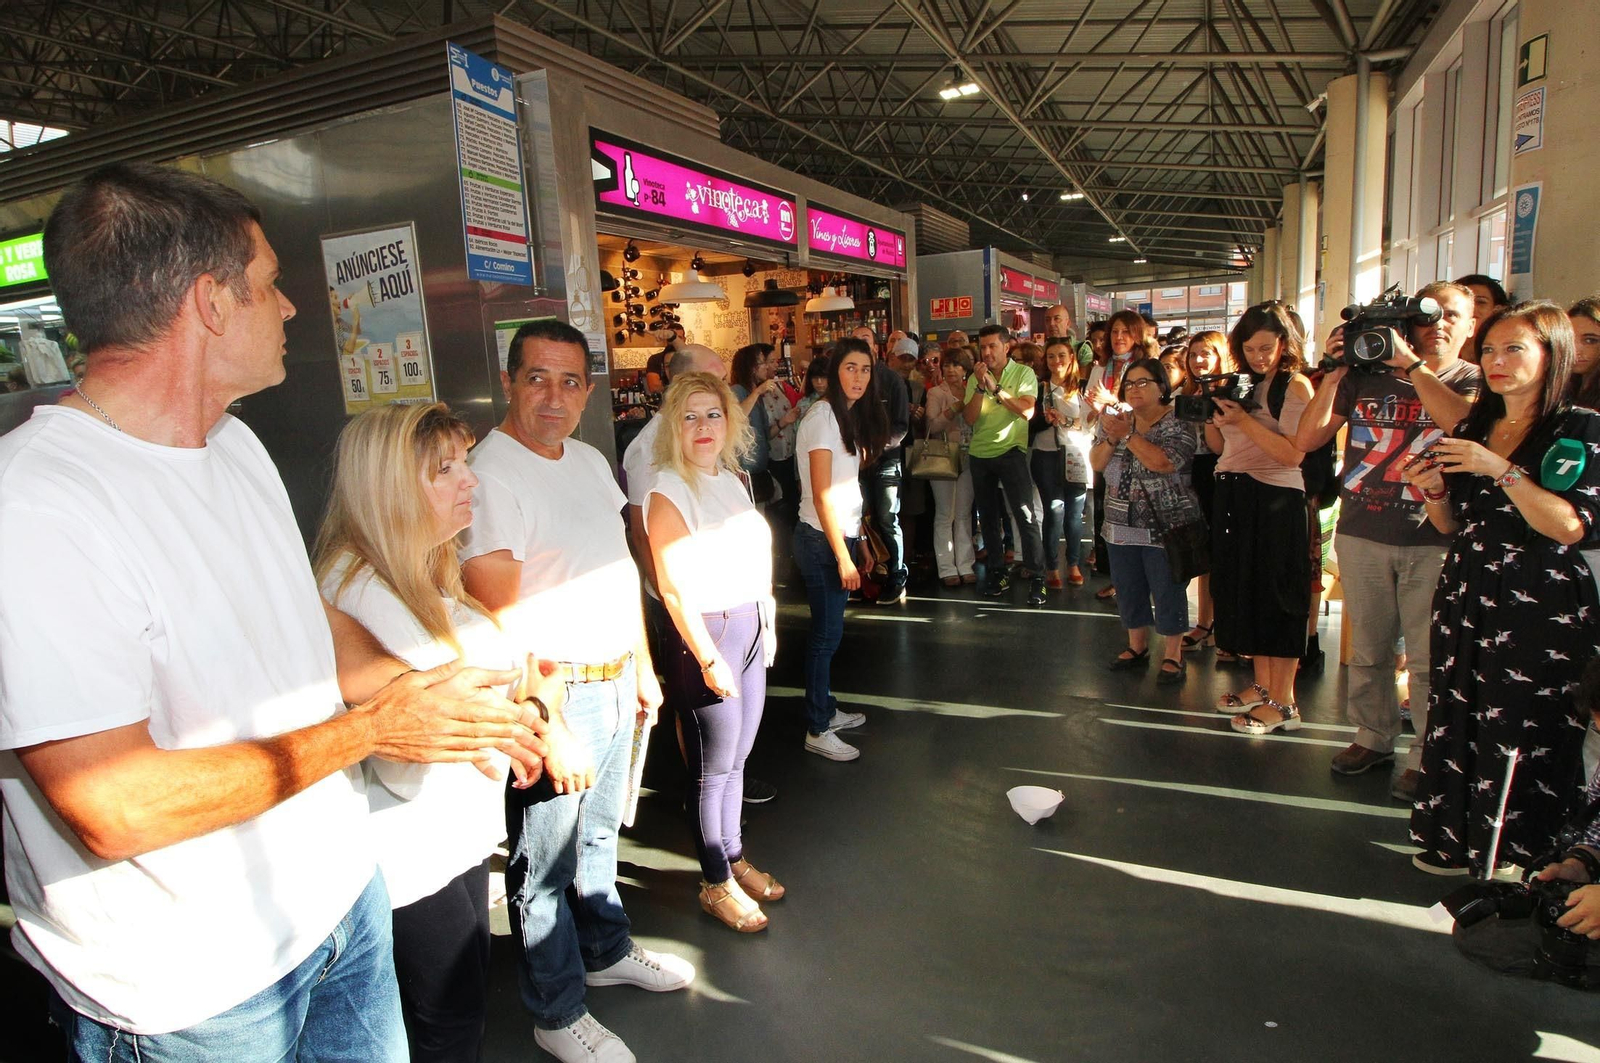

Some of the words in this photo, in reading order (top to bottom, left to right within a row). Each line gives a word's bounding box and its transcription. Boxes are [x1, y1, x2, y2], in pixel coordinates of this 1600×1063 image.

[471, 78, 498, 97] Puestos
[811, 217, 831, 241] Vinos
[5, 262, 37, 282] ROSA
[336, 240, 407, 285] ANÚNCIESE
[484, 260, 491, 269] C/
[493, 261, 514, 272] Comino
[380, 265, 414, 302] AQUÍ
[377, 349, 382, 358] 2
[406, 340, 411, 349] 3
[351, 358, 355, 366] 1
